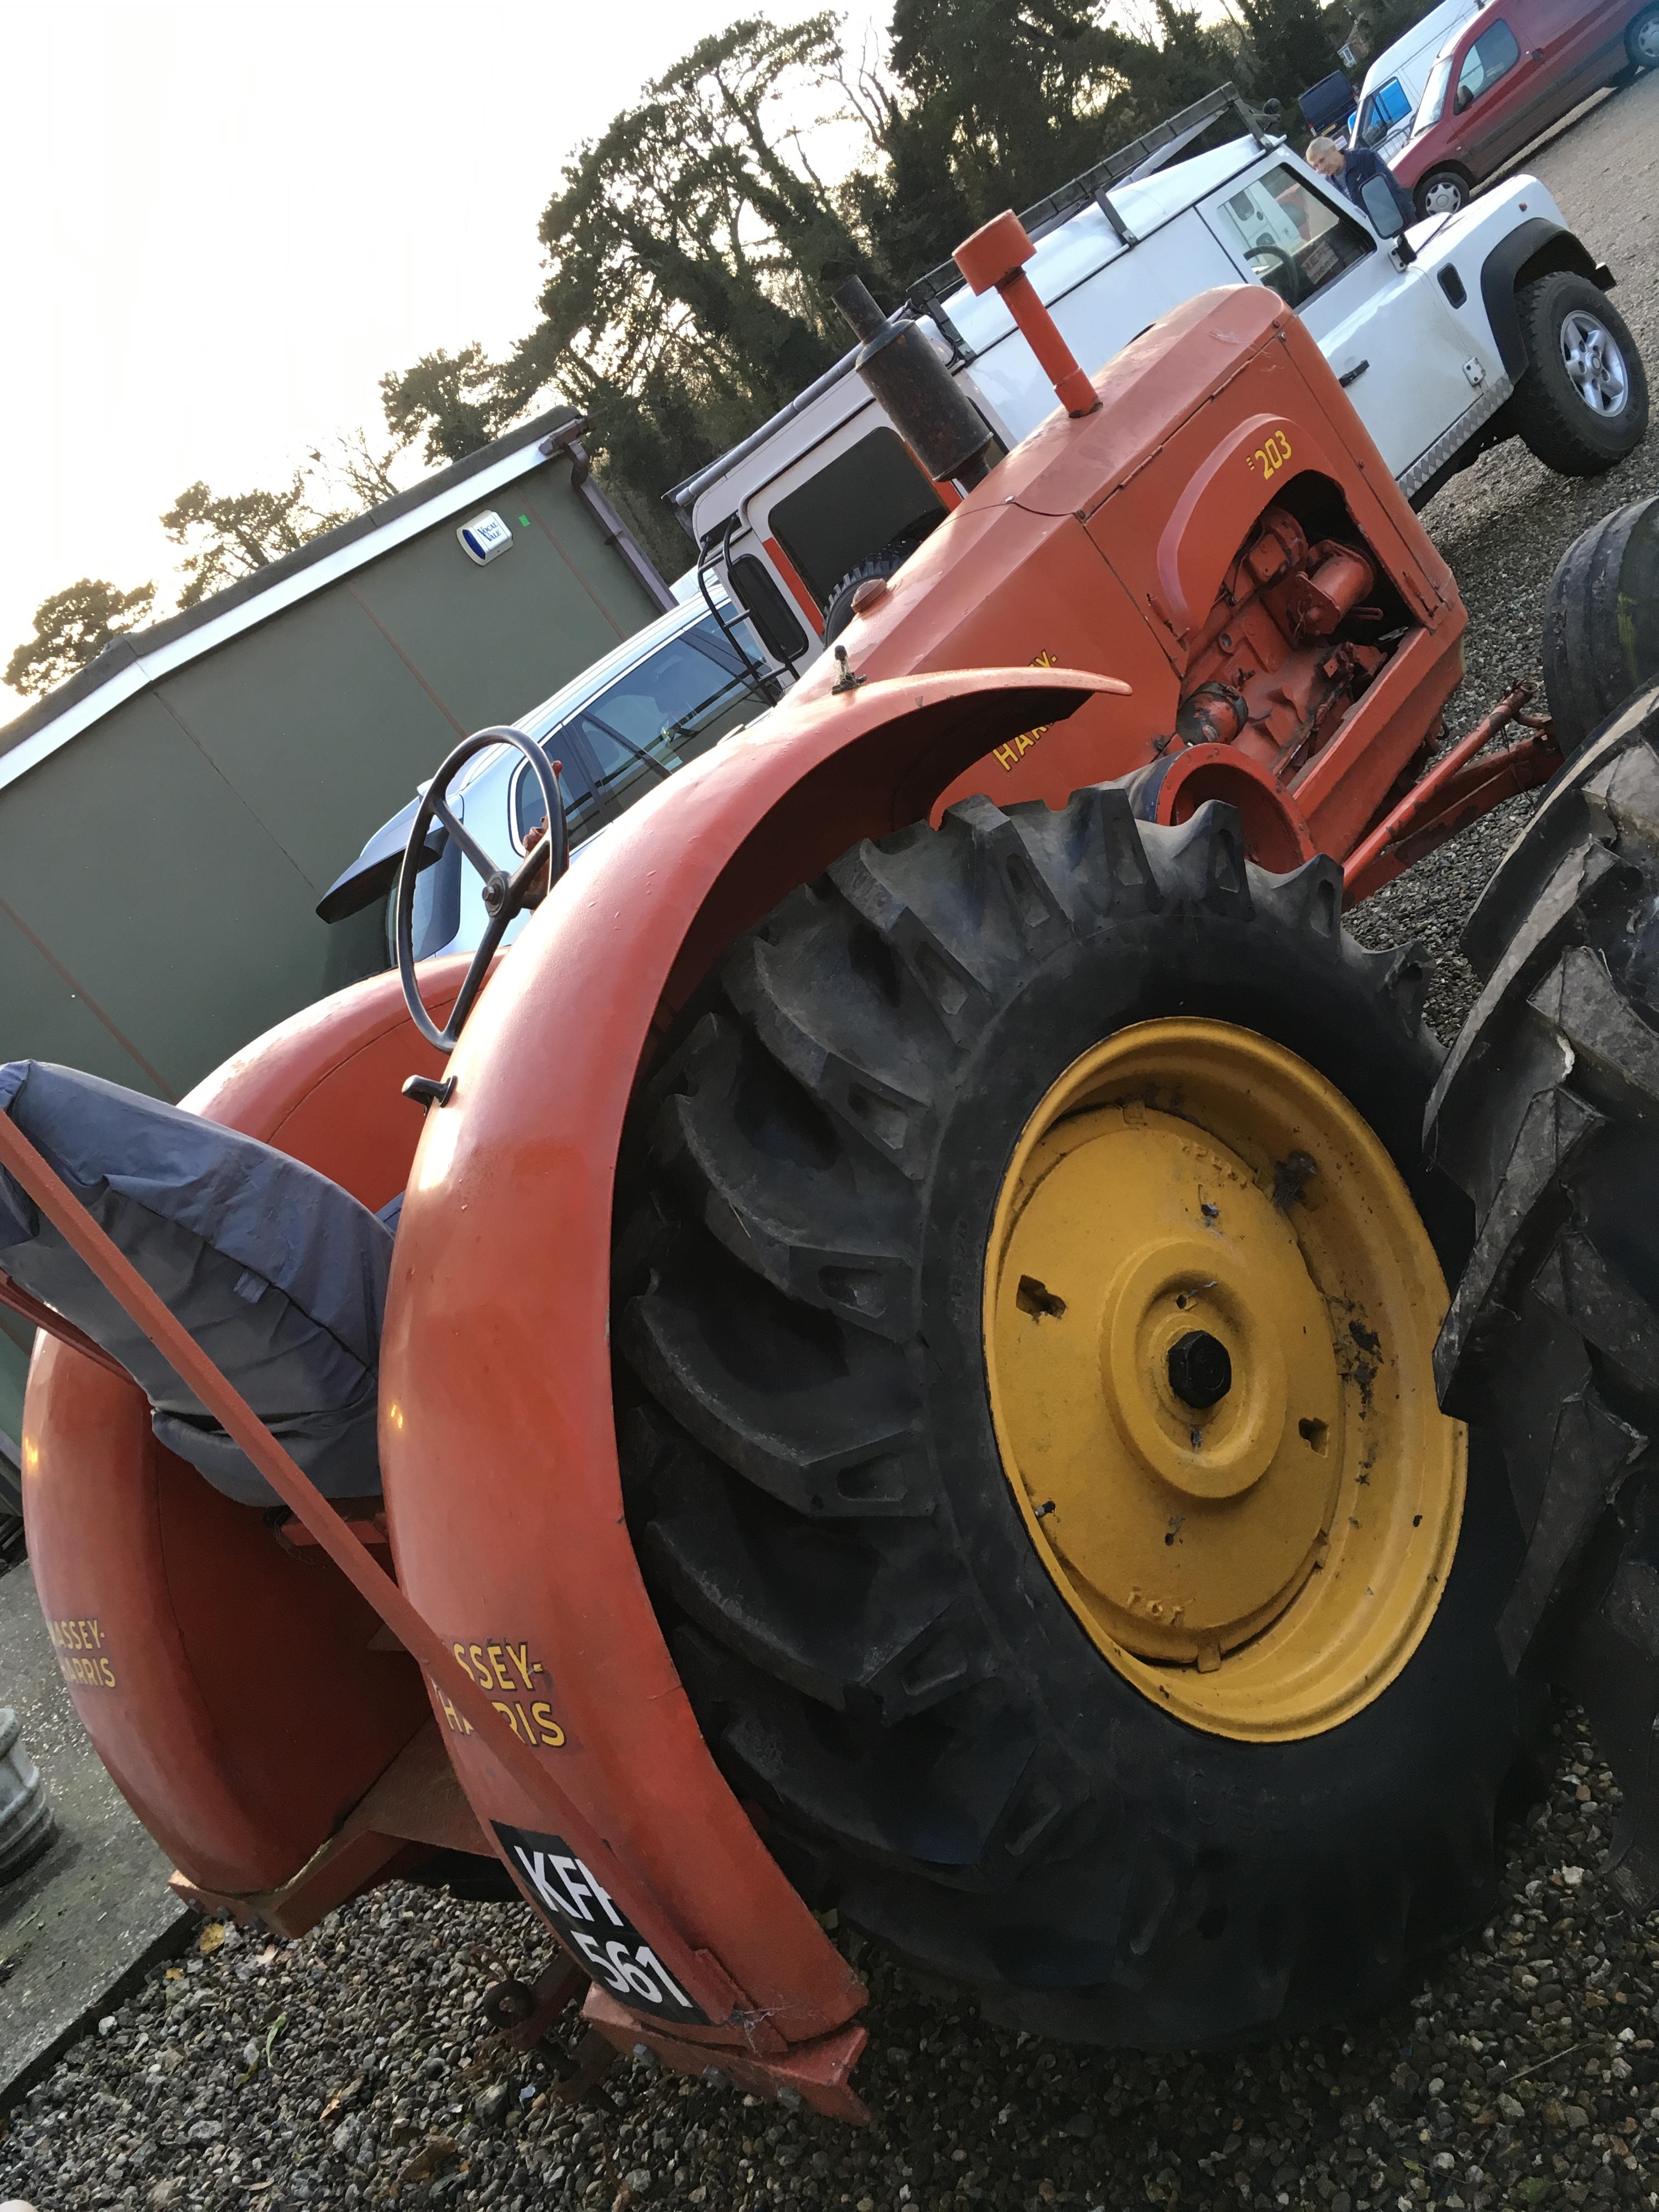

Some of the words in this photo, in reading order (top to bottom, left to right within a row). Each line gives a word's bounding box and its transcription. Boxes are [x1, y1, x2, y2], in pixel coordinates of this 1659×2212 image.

[1255, 430, 1292, 480] 203
[453, 1643, 543, 1689] SSEY-
[570, 1930, 693, 2008] 561
